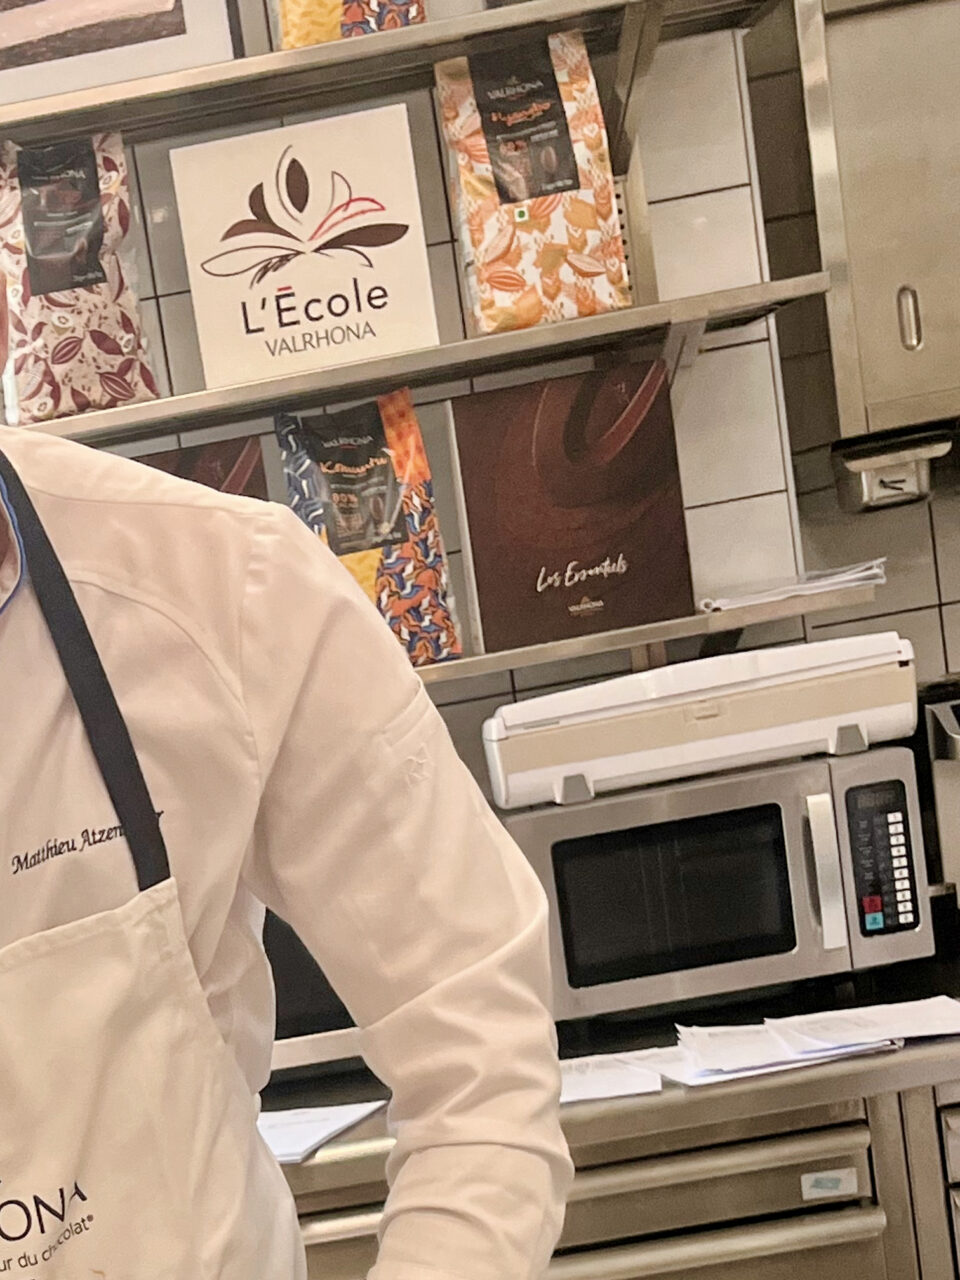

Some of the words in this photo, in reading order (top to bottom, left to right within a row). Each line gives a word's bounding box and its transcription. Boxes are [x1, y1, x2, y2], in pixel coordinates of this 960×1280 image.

[241, 277, 388, 334] L'École
[265, 321, 376, 357] VALRHONA
[12, 838, 77, 874] Matthieu
[79, 824, 125, 852] Atzen
[17, 1252, 38, 1268] du
[41, 1217, 90, 1262] chcolat
